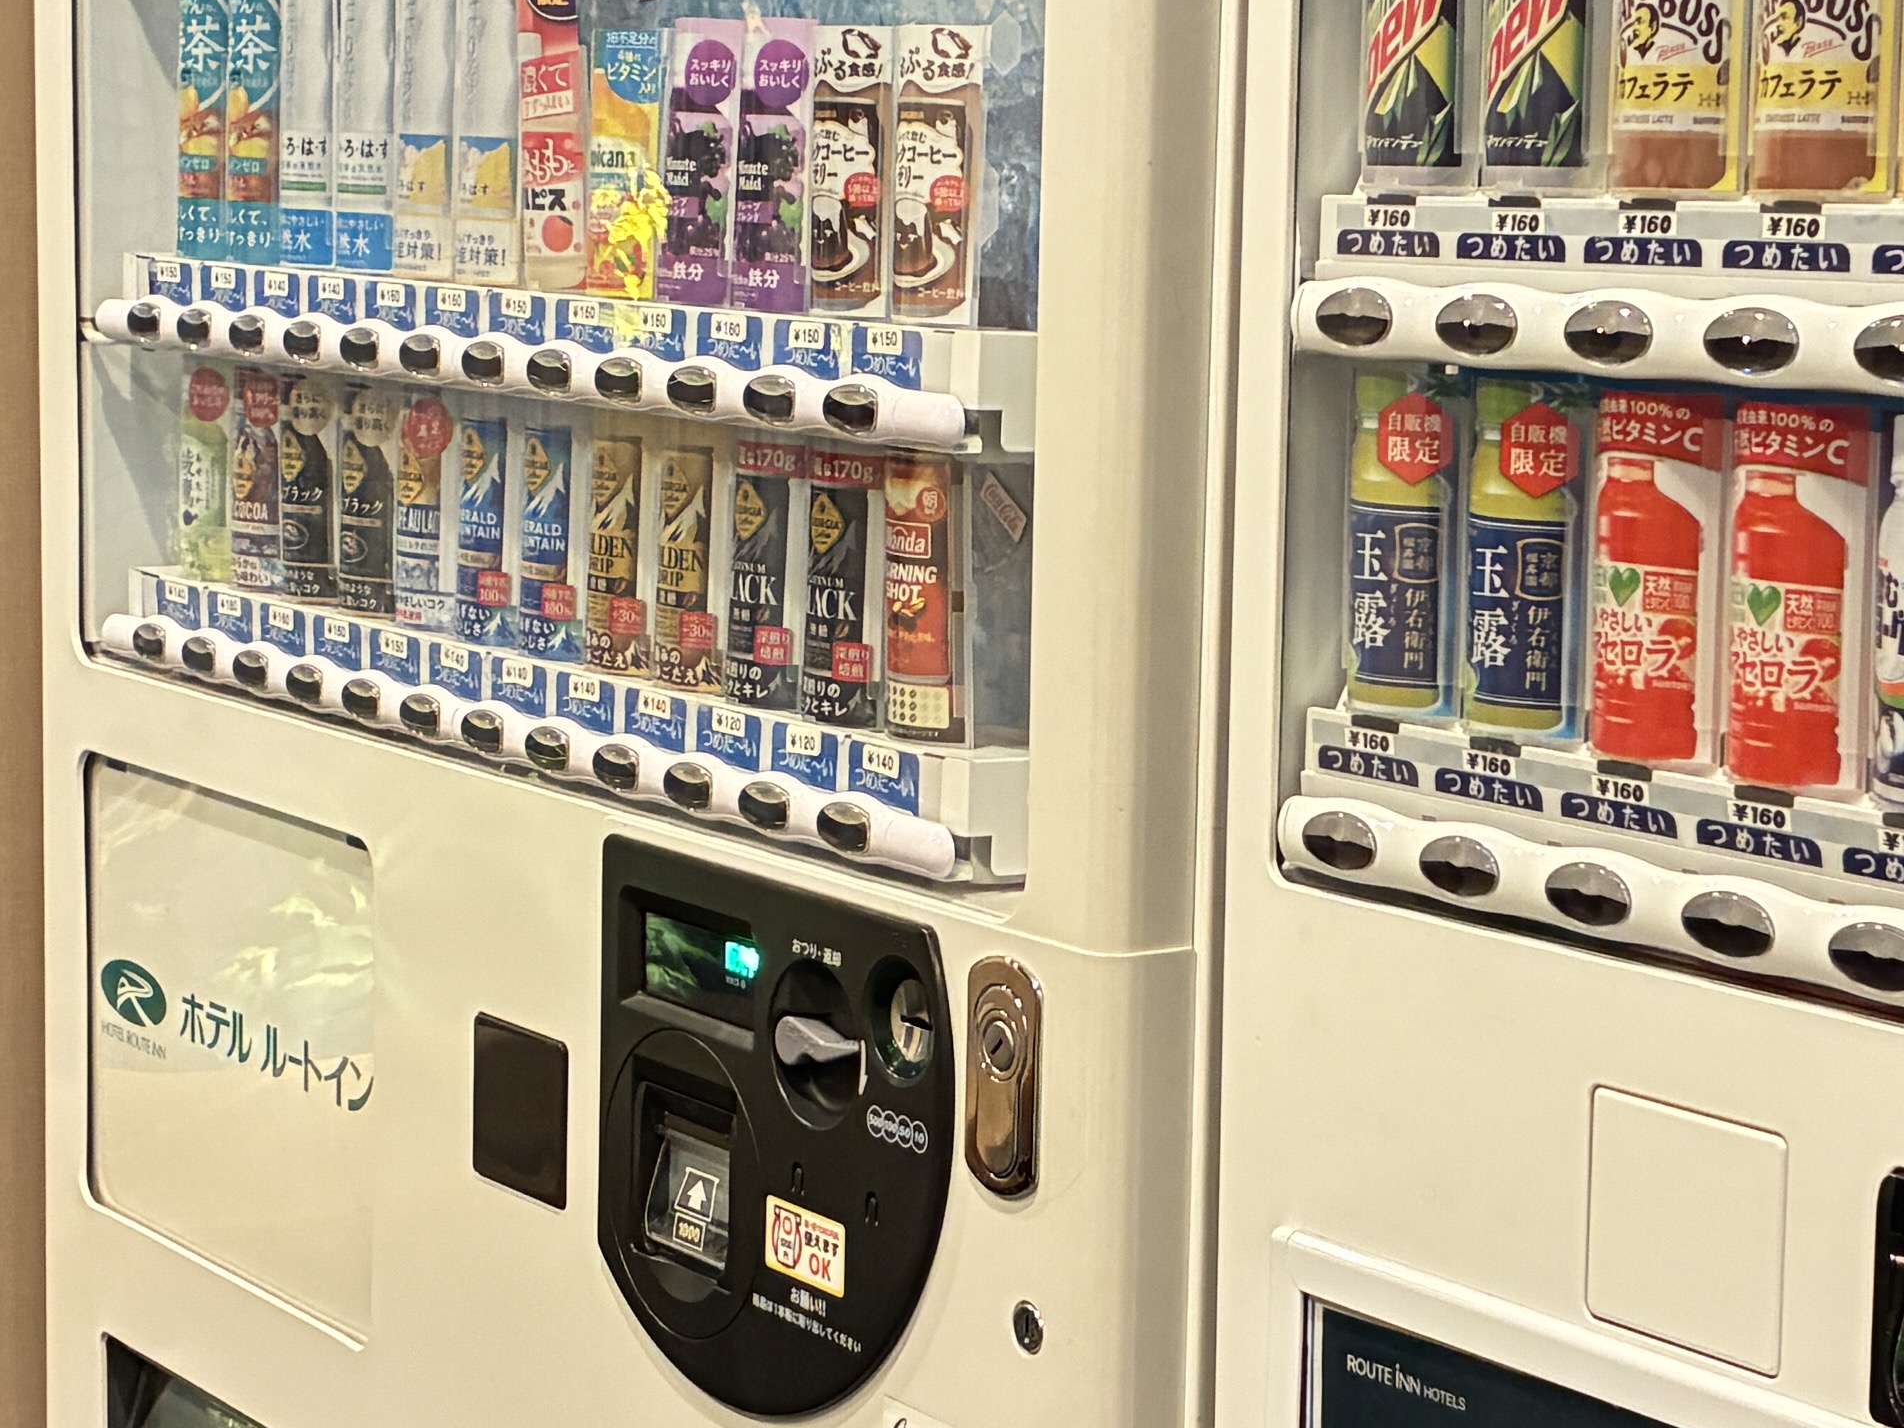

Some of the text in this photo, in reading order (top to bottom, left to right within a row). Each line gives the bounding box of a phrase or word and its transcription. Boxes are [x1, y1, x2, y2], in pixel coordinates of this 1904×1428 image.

[1388, 413, 1441, 434] 自販機
[1510, 425, 1567, 445] 自販機
[1387, 436, 1440, 463] 限定
[1509, 449, 1567, 475] 限定
[1353, 529, 1391, 649] 玉露
[1472, 547, 1512, 668] 玉露
[717, 715, 742, 731] ¥120
[791, 734, 815, 750] ¥120
[1348, 733, 1389, 751] ¥160
[868, 752, 894, 769] ¥140
[180, 994, 374, 1111] ホテル ルートイン
[915, 1131, 924, 1144] 10
[809, 1253, 831, 1282] OK
[1347, 1354, 1392, 1385] ROUTE
[1424, 1386, 1466, 1410] HOTELS
